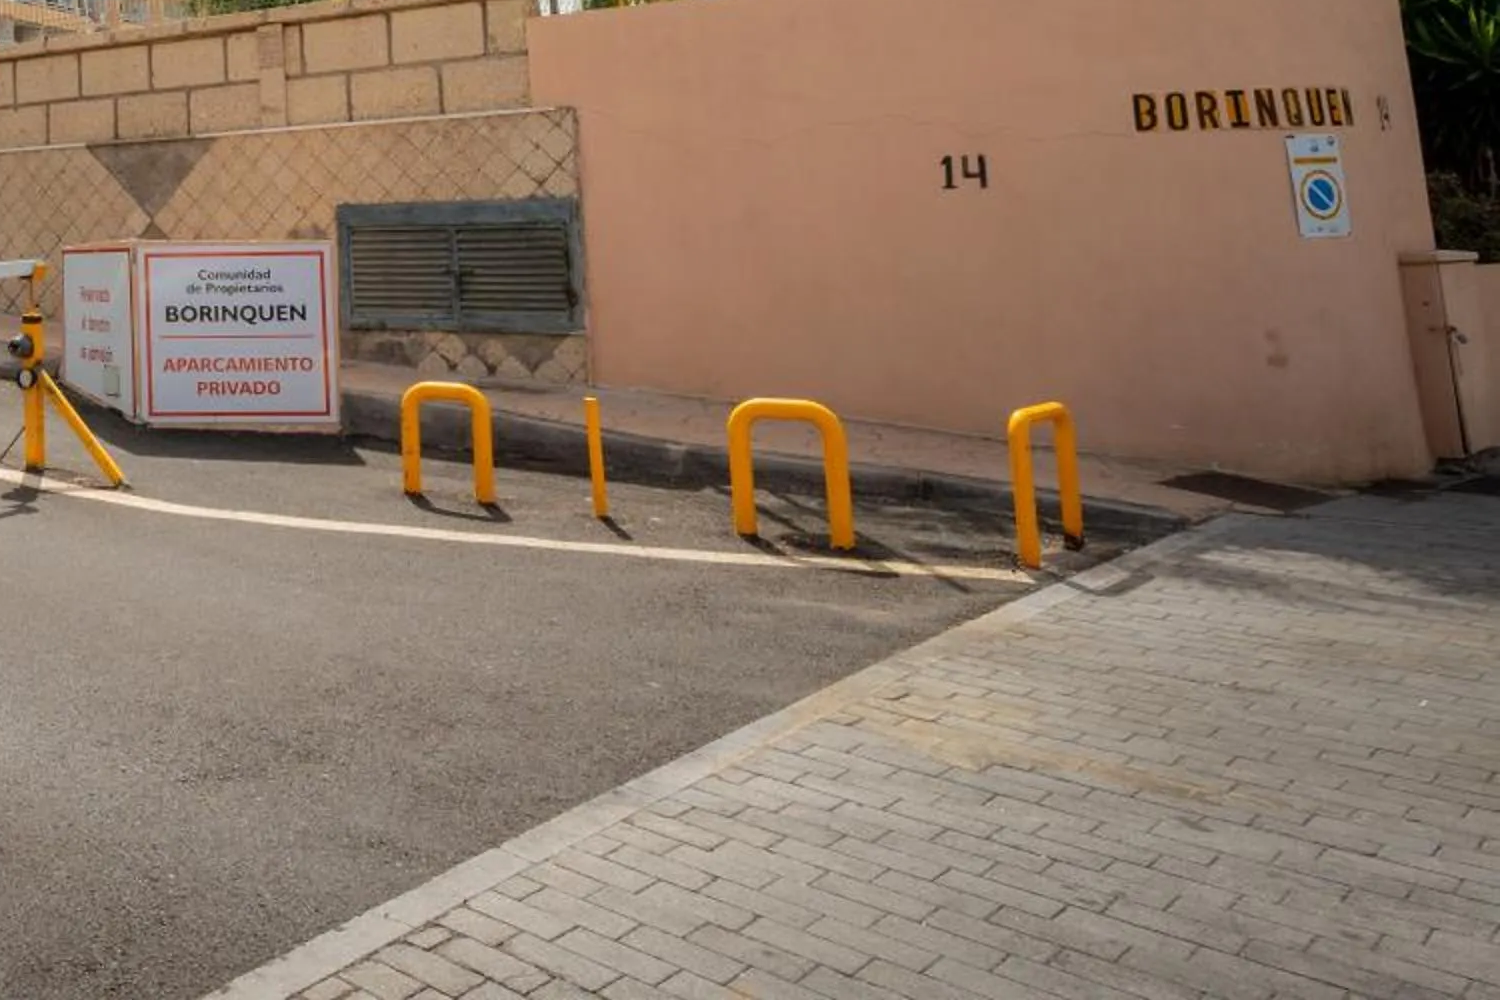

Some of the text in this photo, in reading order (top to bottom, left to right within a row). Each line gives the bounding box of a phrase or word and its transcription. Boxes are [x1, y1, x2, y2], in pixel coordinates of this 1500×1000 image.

[940, 154, 988, 189] 14
[197, 269, 271, 280] Comunidad
[186, 281, 284, 296] de Propietarios
[165, 304, 307, 324] BORINQUEN
[163, 357, 313, 373] APARCAMIENTO
[197, 380, 281, 396] PRIVADO
